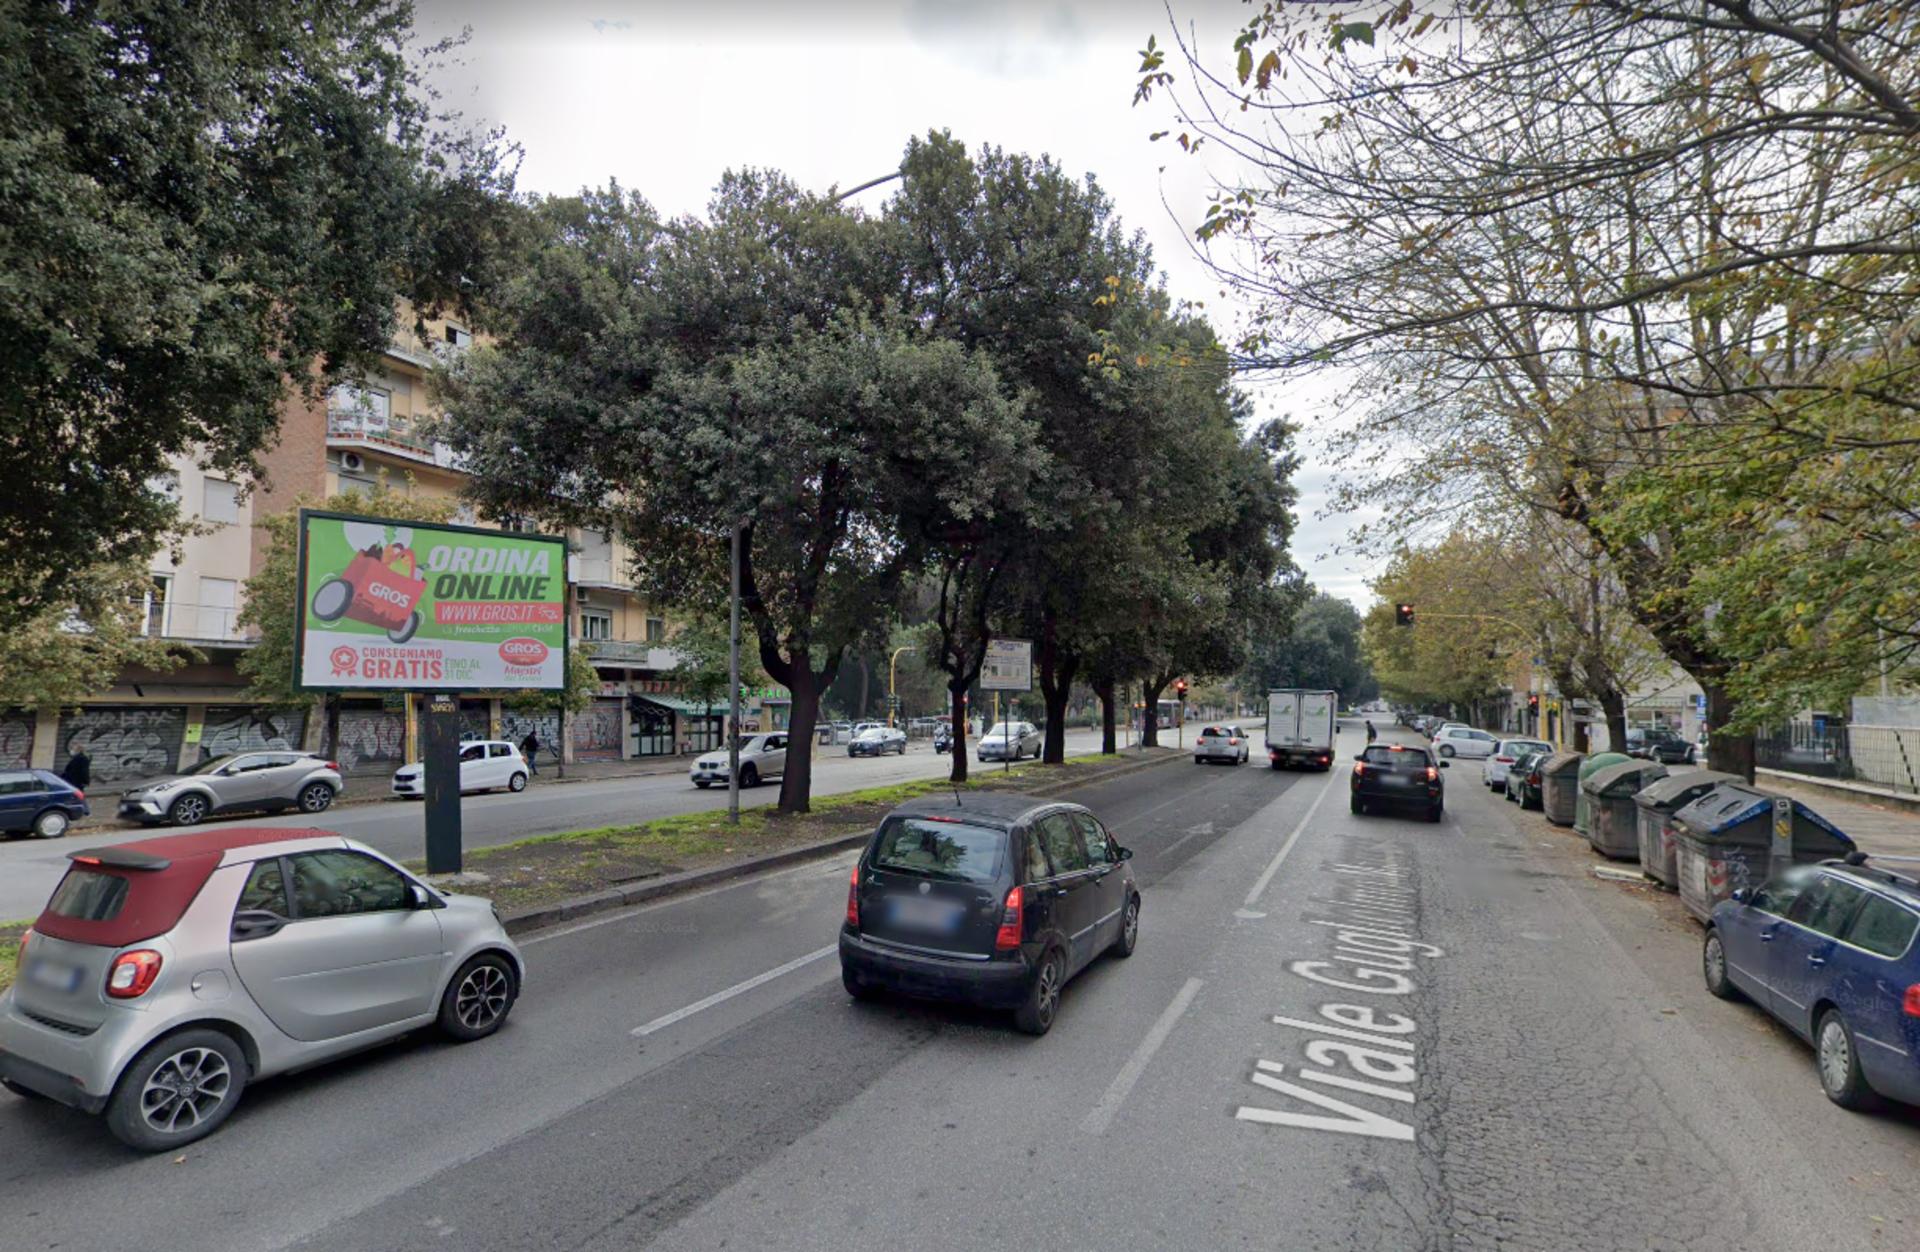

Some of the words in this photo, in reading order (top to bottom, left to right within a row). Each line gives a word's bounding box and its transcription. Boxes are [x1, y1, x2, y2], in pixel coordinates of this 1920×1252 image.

[428, 546, 549, 575] ORDINA
[369, 582, 411, 608] GROS
[433, 574, 551, 600] ONLINE
[441, 604, 534, 621] WWW.GROS.IT
[361, 647, 443, 659] CONSEGNIAMO
[504, 642, 542, 655] GROS
[361, 658, 443, 680] GRATIS
